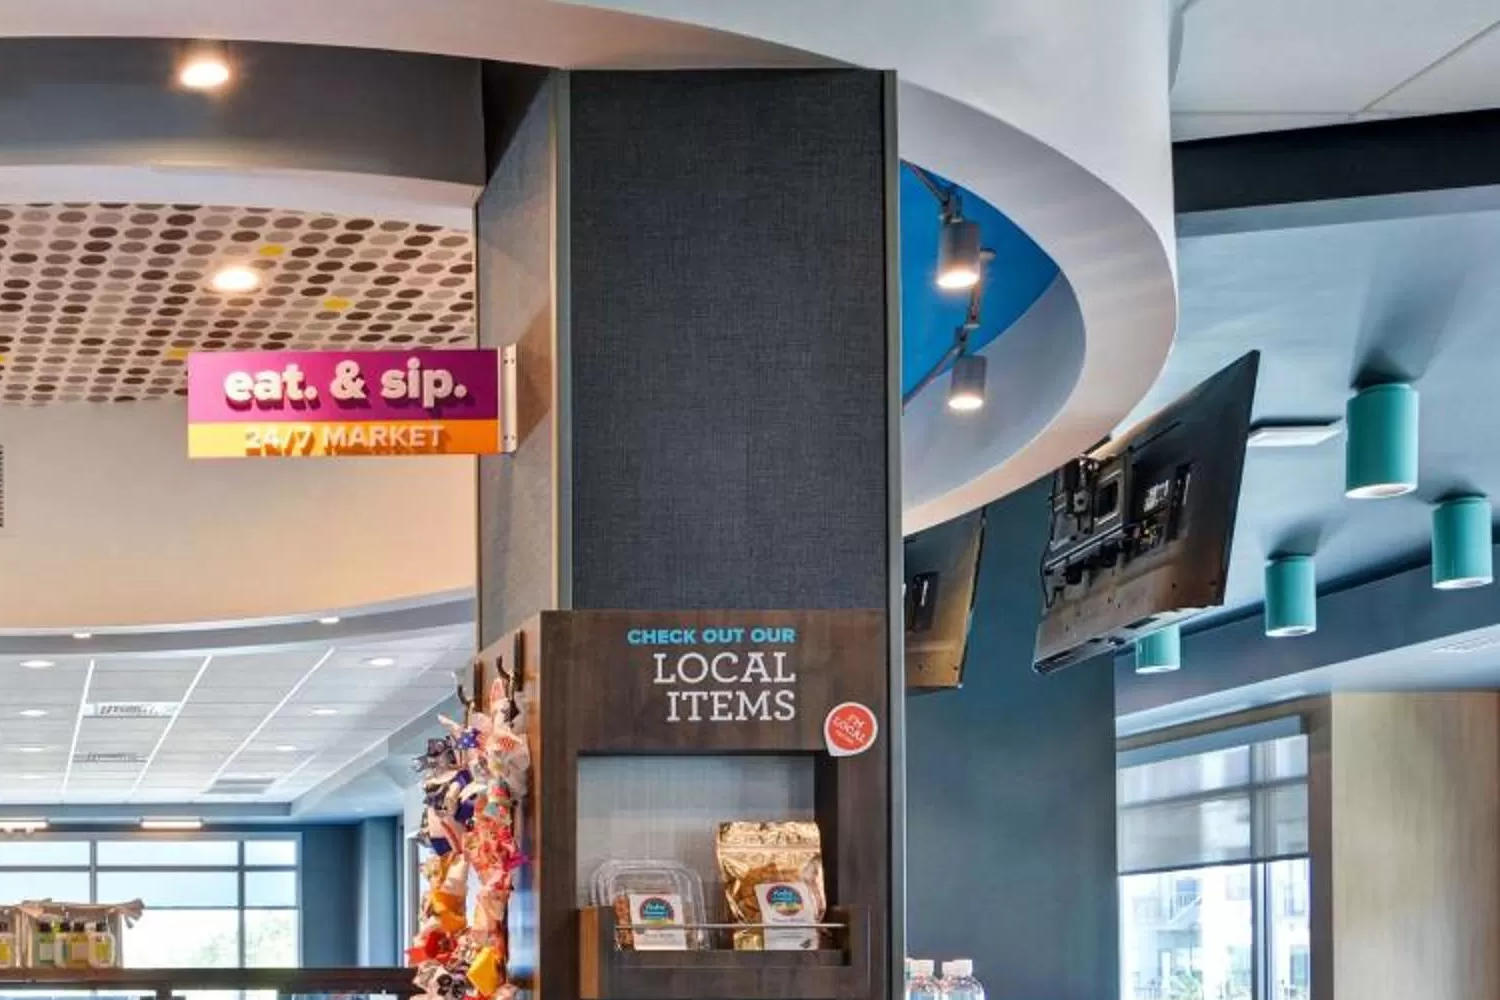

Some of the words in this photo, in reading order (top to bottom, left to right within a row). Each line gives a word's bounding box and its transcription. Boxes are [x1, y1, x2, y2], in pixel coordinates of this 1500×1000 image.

[224, 363, 317, 401] eat.
[331, 359, 367, 400] &
[380, 357, 468, 408] sip.
[246, 425, 313, 449] 24/7
[323, 425, 445, 449] MARKET
[627, 629, 697, 645] CHECK
[702, 629, 745, 644] OUT
[750, 628, 796, 643] OUR
[653, 652, 796, 684] LOCAL
[666, 689, 796, 721] ITEMS
